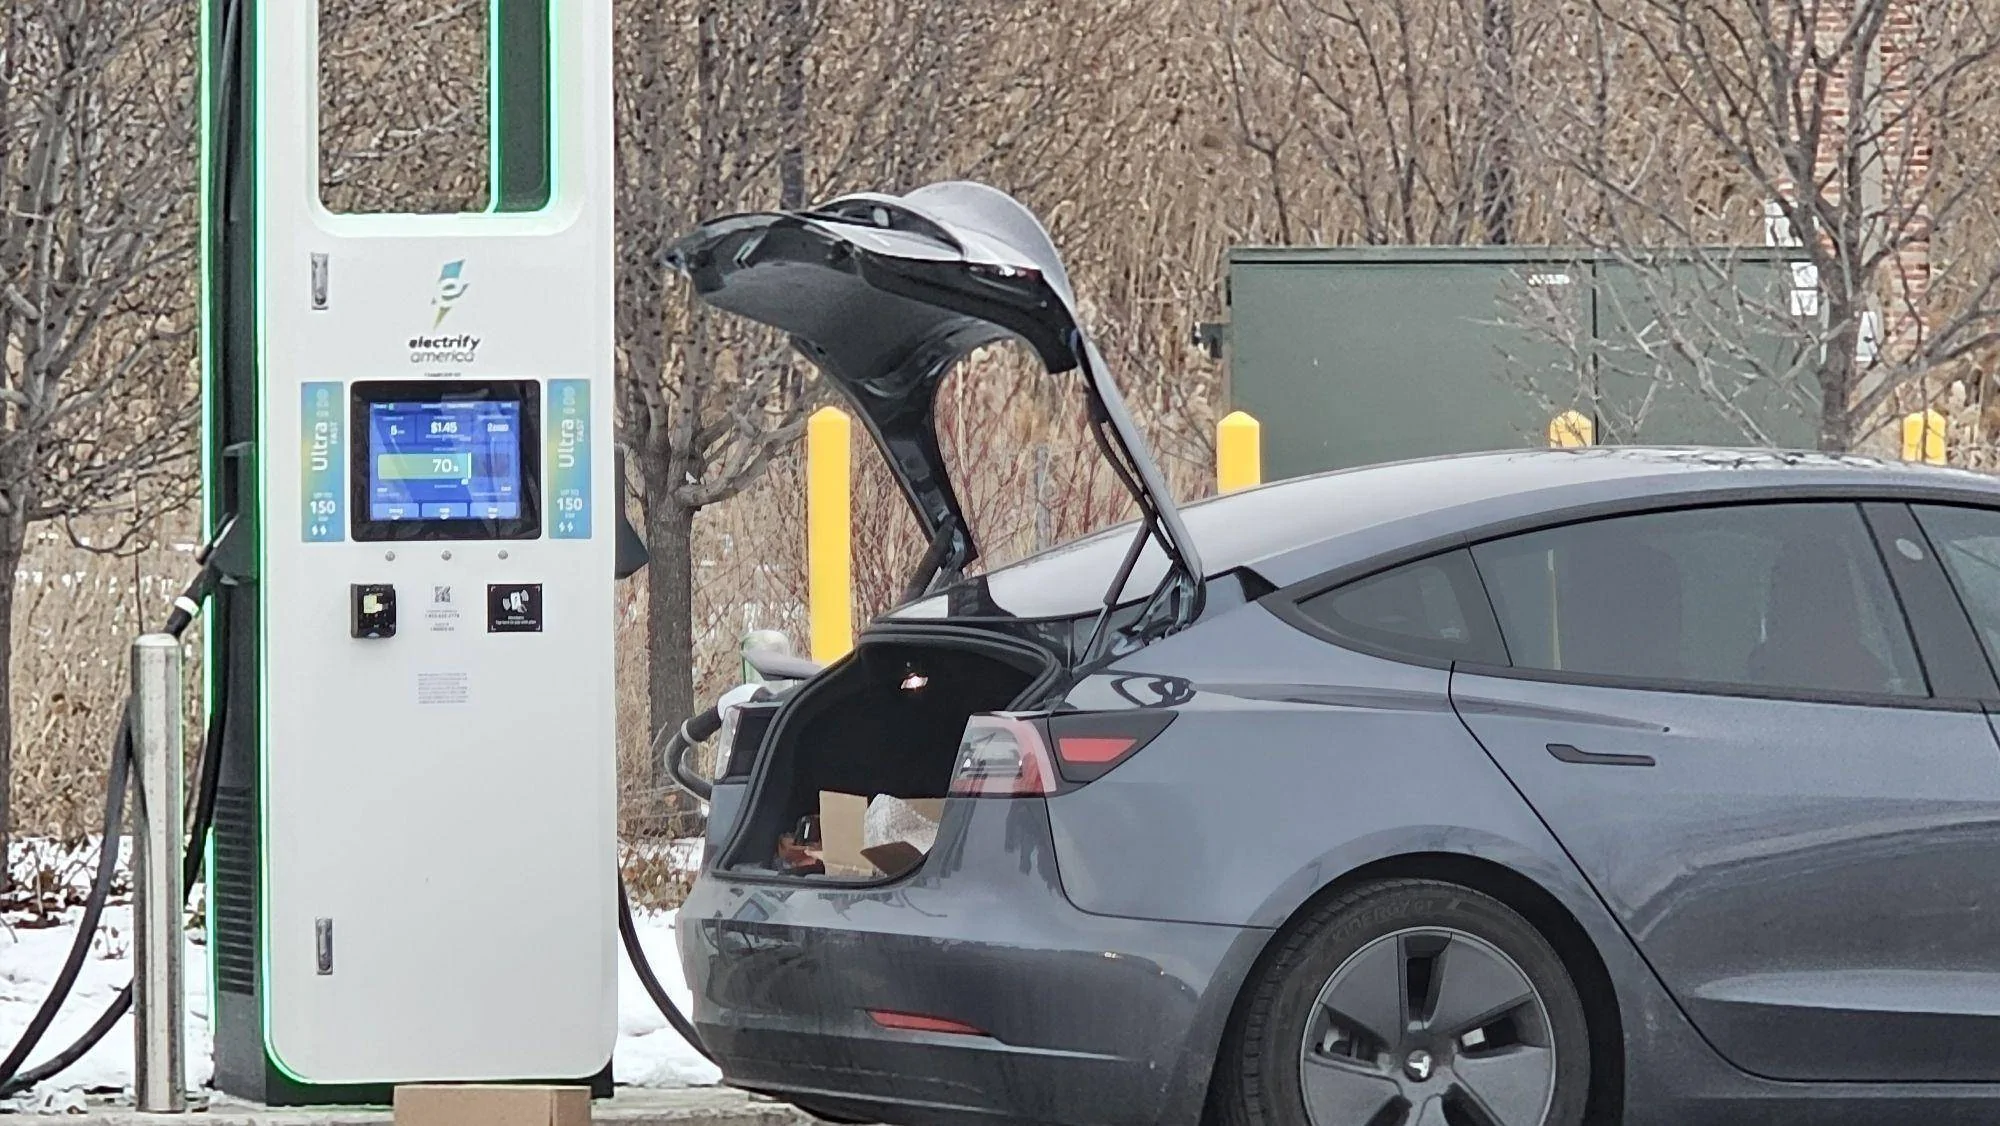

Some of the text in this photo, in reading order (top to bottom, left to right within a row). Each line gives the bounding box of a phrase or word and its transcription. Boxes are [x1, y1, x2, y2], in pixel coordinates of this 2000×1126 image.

[408, 334, 481, 351] electrify
[410, 351, 476, 363] america
[311, 421, 328, 471] Ultra
[557, 418, 575, 468] Ultra
[310, 500, 336, 514] 150
[556, 497, 583, 511] 150
